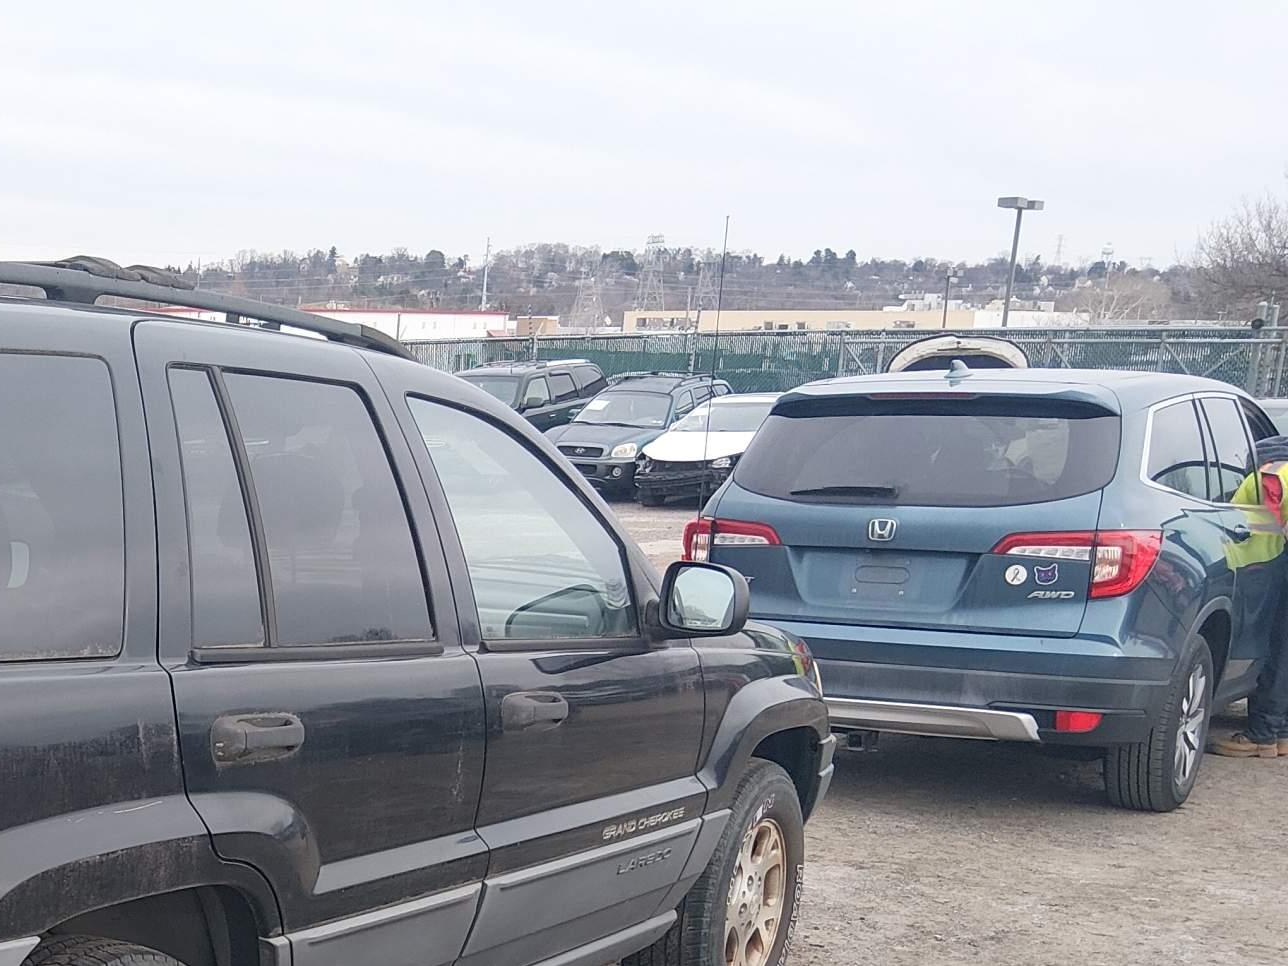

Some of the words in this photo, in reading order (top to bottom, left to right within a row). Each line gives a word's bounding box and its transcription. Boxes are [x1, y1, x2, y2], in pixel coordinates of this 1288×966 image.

[1027, 590, 1075, 599] AWD
[602, 819, 637, 841] GRAND
[638, 806, 686, 831] CHEROKEE
[616, 847, 673, 875] LAREDO
